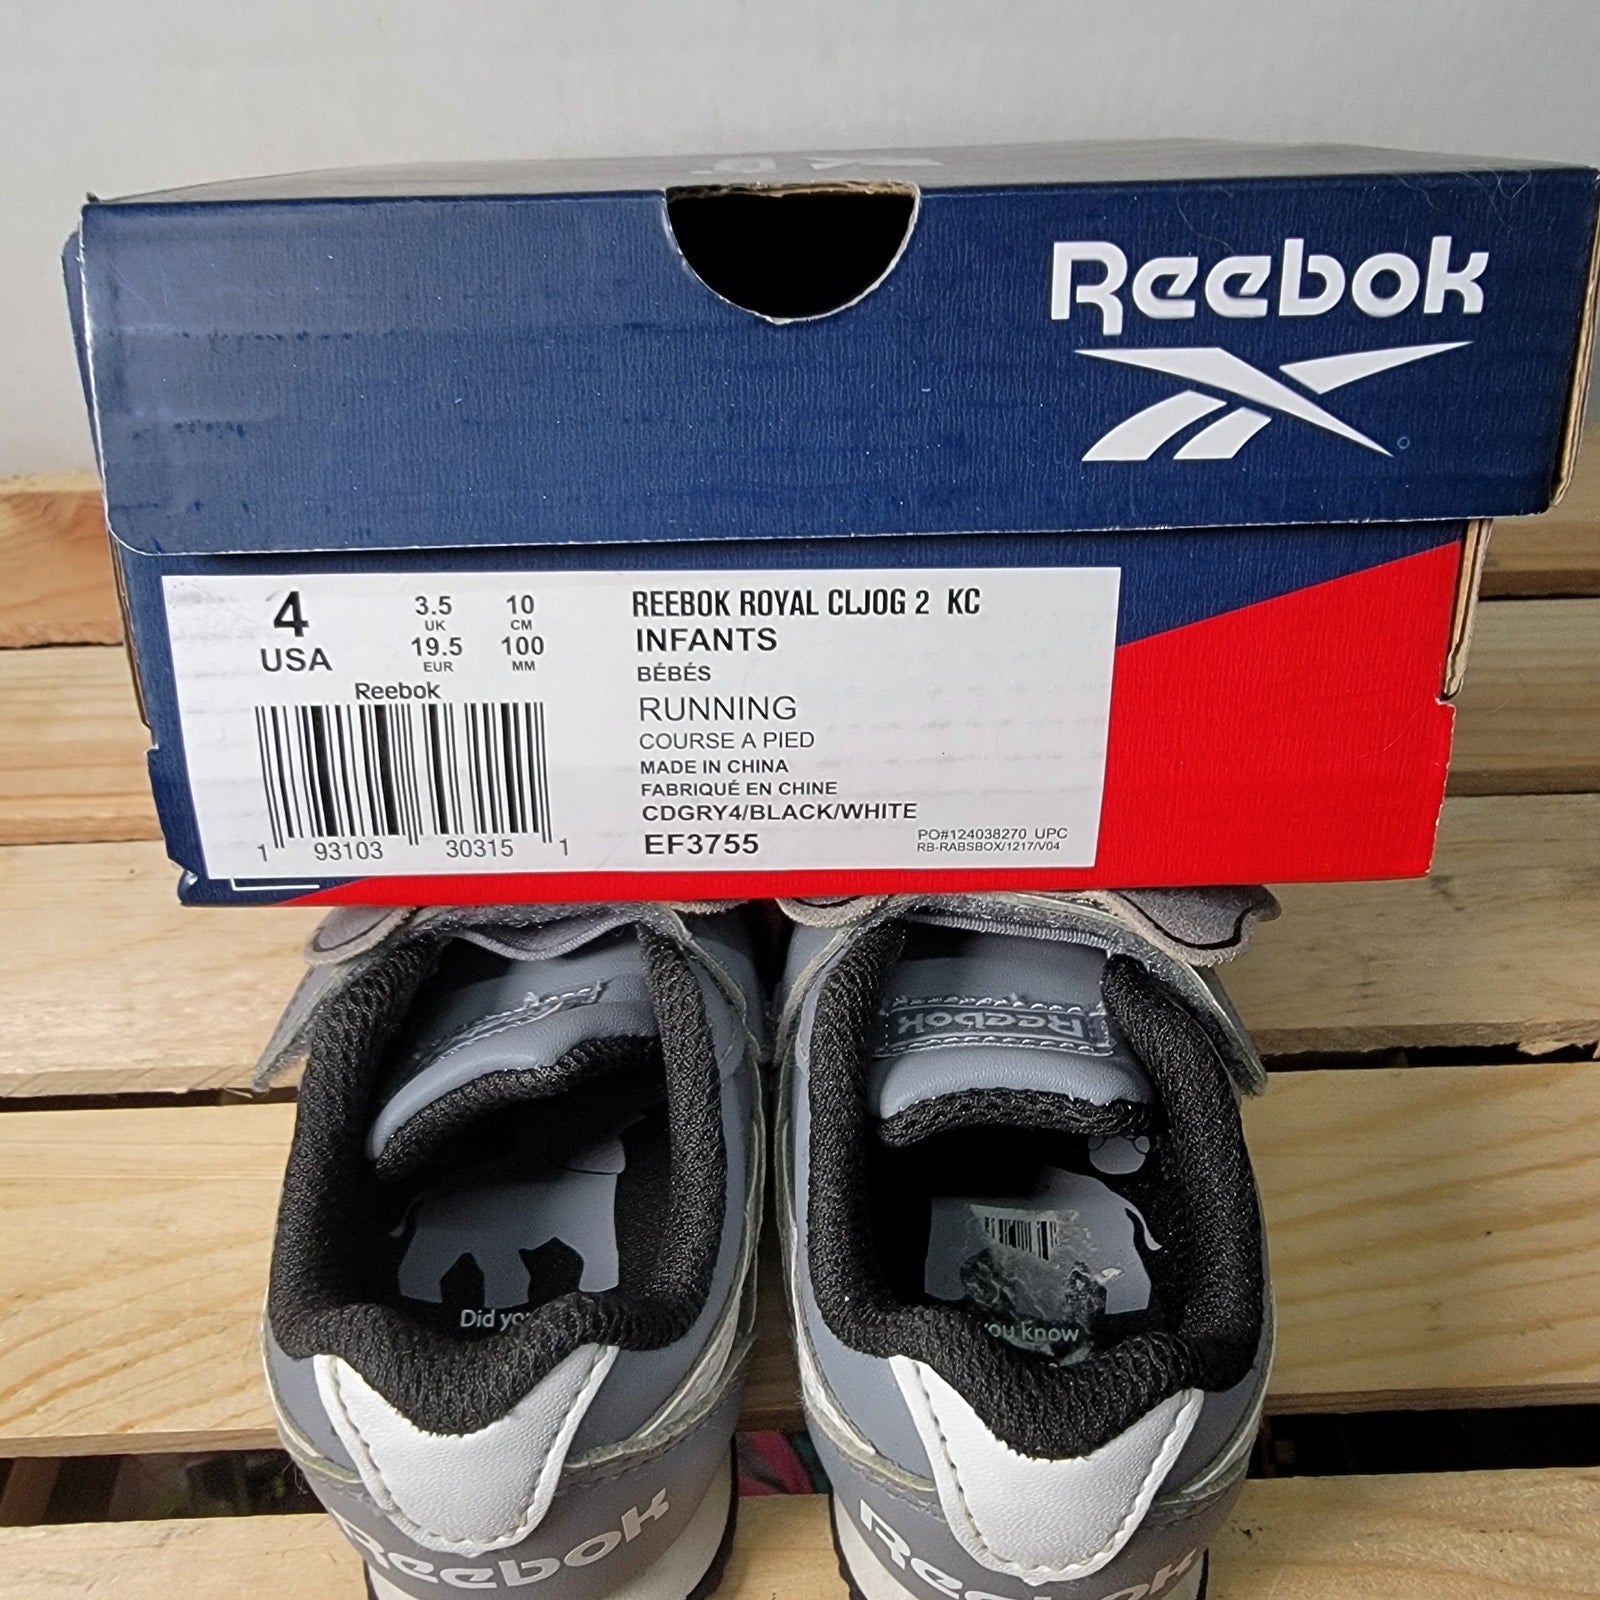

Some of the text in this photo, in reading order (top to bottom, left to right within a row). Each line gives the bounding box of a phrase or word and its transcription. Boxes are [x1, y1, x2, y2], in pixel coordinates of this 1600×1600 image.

[1051, 236, 1489, 335] Reebok
[416, 595, 452, 616] 3.5
[507, 595, 535, 614] 10
[633, 588, 980, 617] REEBOK ROYAL CLJOG 2 KC
[274, 591, 309, 637] 4
[425, 620, 446, 631] UK
[511, 619, 532, 630] CM
[412, 637, 463, 656] 19.5
[501, 636, 544, 655] 100
[636, 627, 777, 652] INFANTS
[261, 648, 333, 672] USA
[424, 661, 453, 672] EUR
[512, 660, 536, 671] MM
[638, 662, 711, 682] BÉBÉS
[355, 682, 441, 699] Reebok
[640, 695, 797, 721] RUNNING
[639, 732, 815, 750] COURSE A PIED
[640, 760, 789, 774] MADE IN CHINA
[641, 780, 837, 797] FABRIQUÉ EN CHINE
[642, 803, 918, 822] CDGRY4/BLACK/WHITE
[645, 833, 759, 855] EF3755
[918, 828, 1068, 841] PO#124038270 UPC
[257, 839, 569, 862] 1 93103 30315 1
[917, 842, 1060, 852] RB-RABSBOX/1217/V04
[899, 1011, 1084, 1038] Reebok
[461, 1308, 530, 1332] Did yo
[984, 1321, 1079, 1341] ou know
[330, 1487, 670, 1589] Reebok
